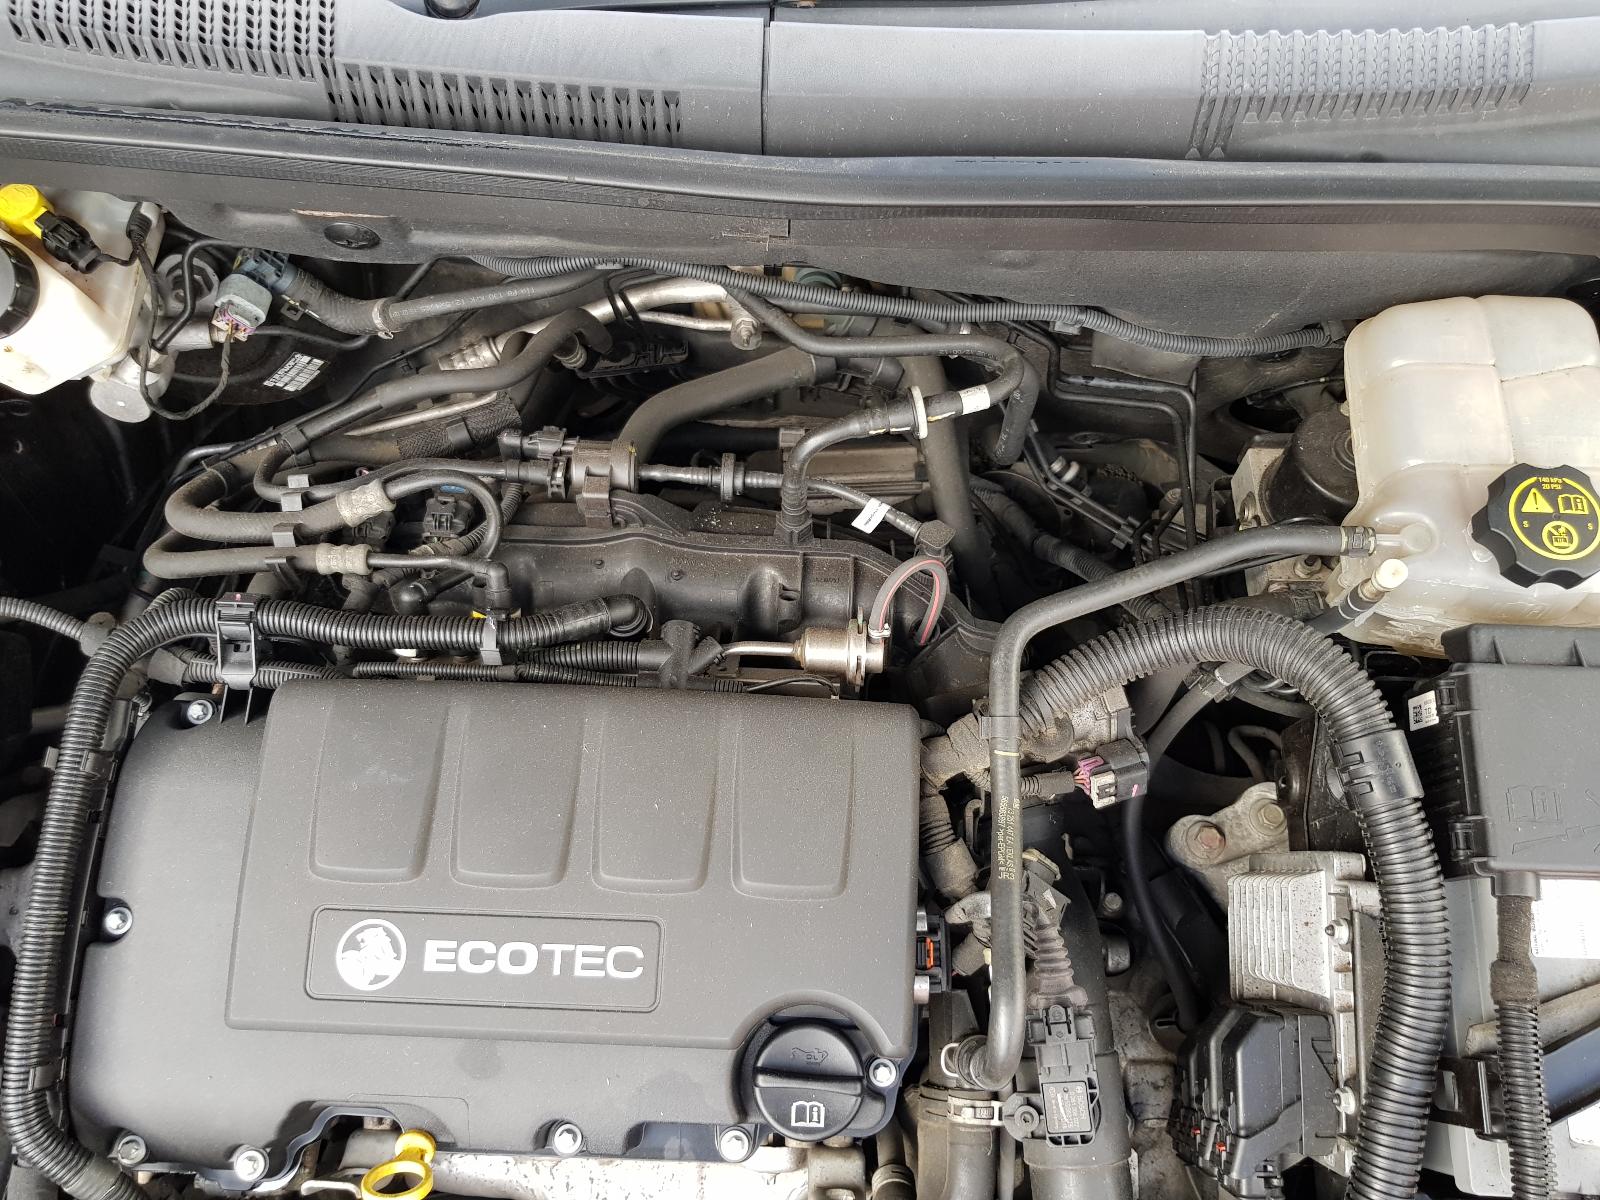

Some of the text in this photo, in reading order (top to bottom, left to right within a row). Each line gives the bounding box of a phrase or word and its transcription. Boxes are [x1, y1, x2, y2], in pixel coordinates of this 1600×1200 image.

[1522, 520, 1529, 528] S
[1587, 522, 1593, 530] S
[423, 939, 644, 979] ECOTEC
[1077, 1094, 1087, 1120] BOSCH
